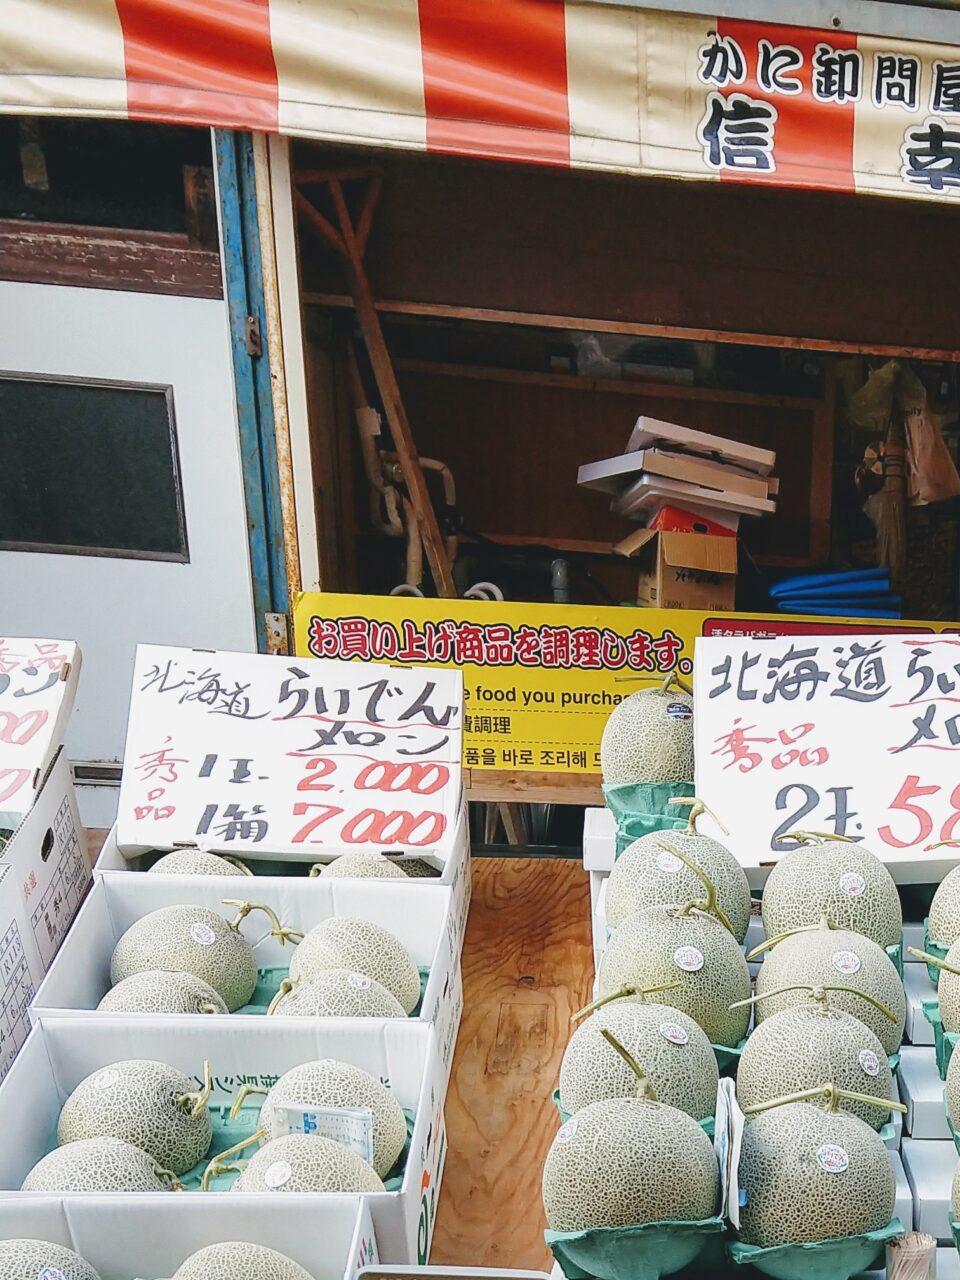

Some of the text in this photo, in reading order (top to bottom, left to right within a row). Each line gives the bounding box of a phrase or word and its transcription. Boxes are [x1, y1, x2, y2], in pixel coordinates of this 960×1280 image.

[309, 615, 694, 675] お買い上げ商品を調理します。
[475, 686, 516, 702] food
[521, 688, 555, 707] you
[297, 720, 451, 756] メロン
[502, 750, 535, 767] 바로
[540, 751, 587, 768] 조리해
